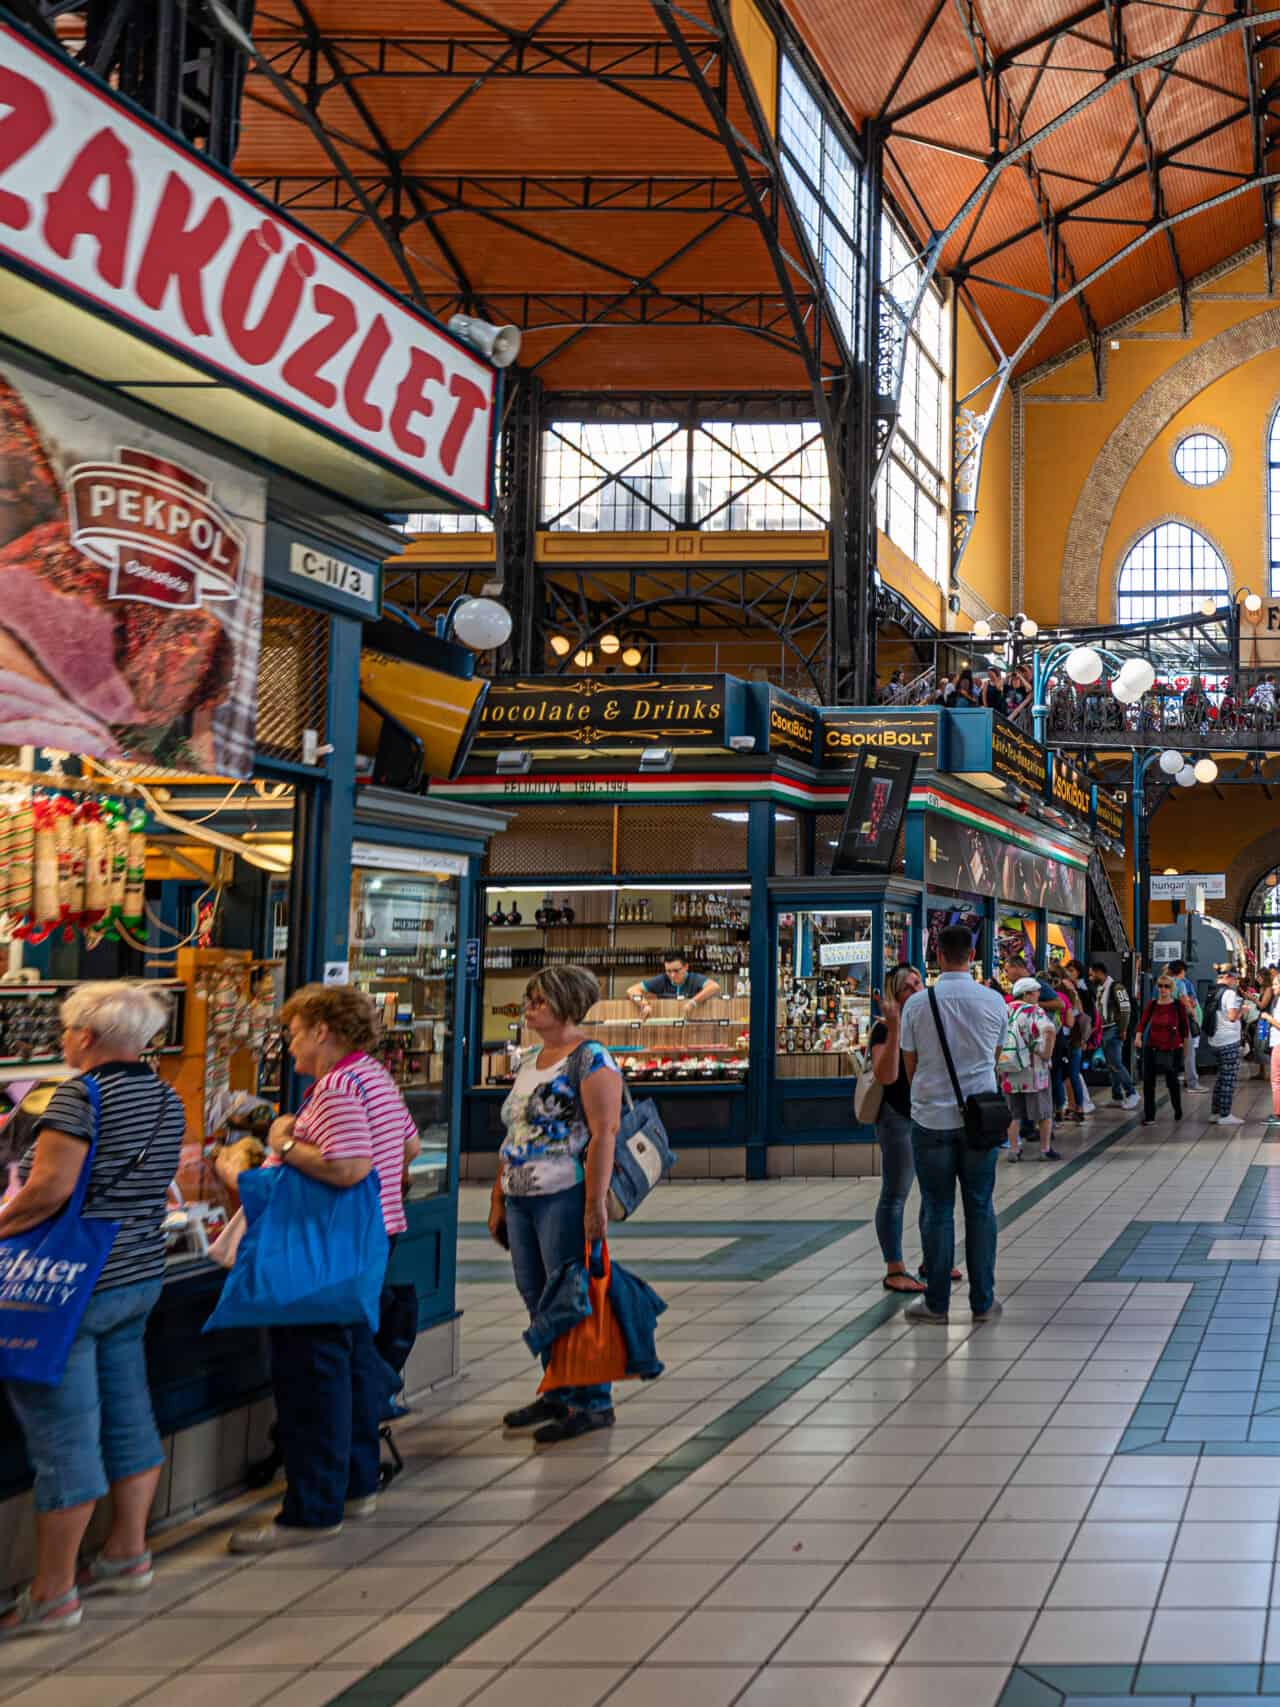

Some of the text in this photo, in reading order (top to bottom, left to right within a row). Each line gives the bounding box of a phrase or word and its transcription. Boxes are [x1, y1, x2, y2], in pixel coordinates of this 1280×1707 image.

[89, 484, 231, 565] PEKPOL
[480, 698, 721, 721] ocolate & Drinks
